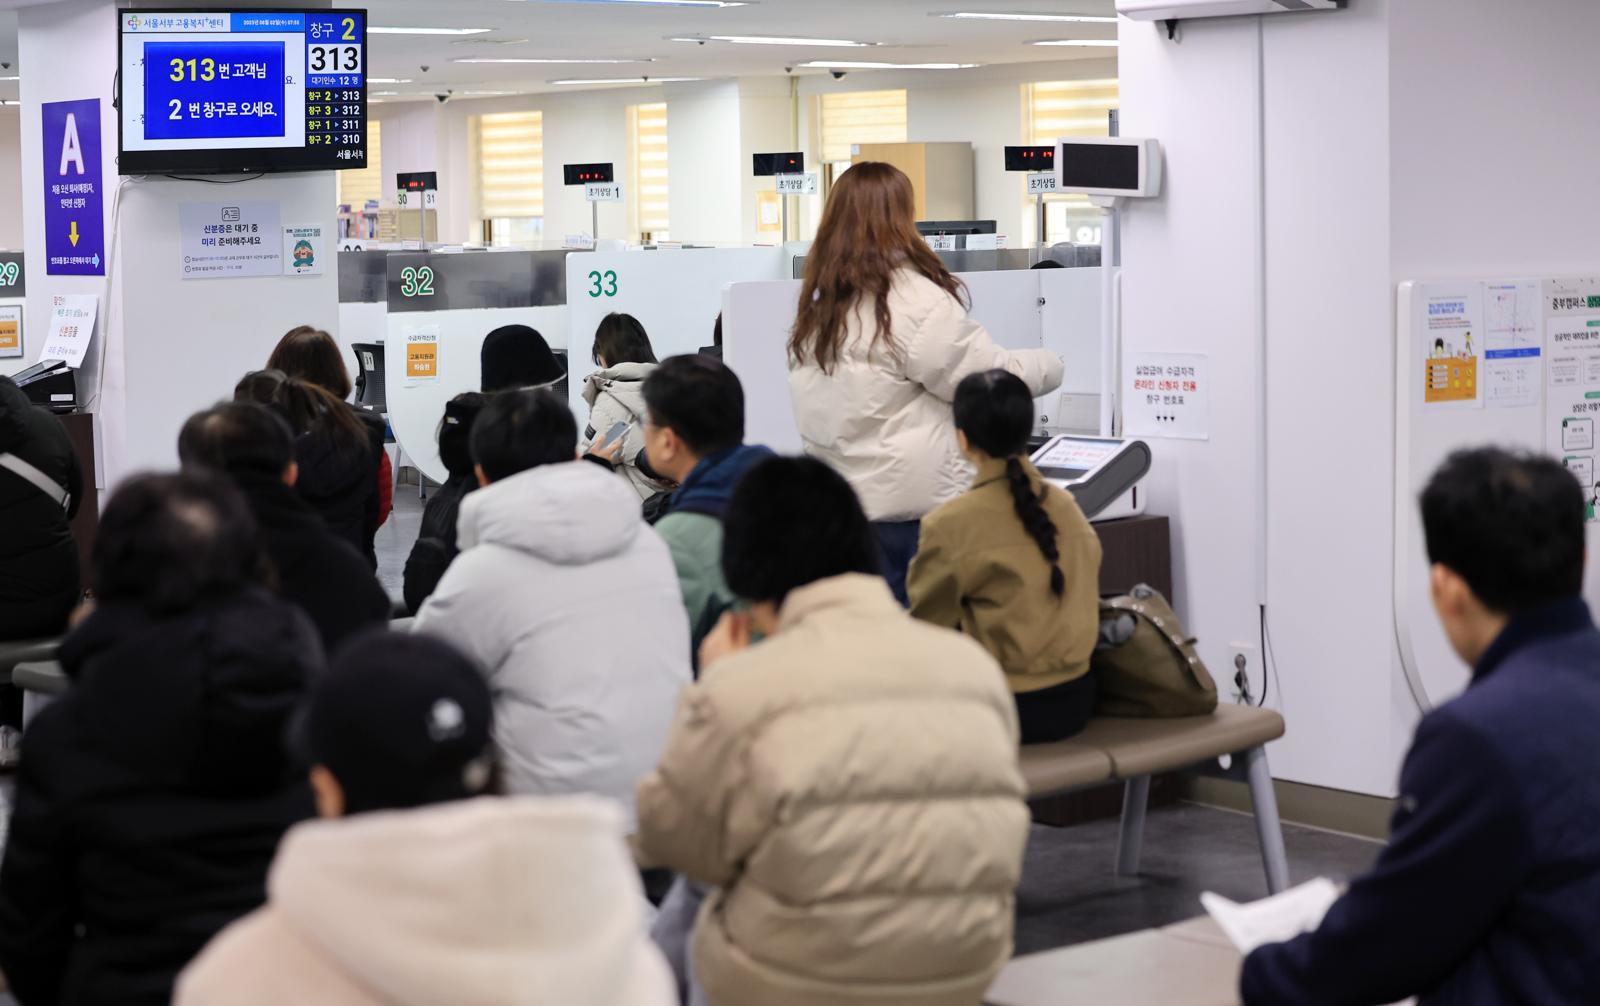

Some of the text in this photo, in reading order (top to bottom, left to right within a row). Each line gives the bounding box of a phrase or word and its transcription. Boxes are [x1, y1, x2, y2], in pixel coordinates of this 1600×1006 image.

[143, 18, 174, 29] 서울서부
[310, 17, 356, 41] 창구 2
[311, 46, 358, 71] 313
[169, 57, 267, 82] 313 번 고객님
[311, 76, 359, 86] 대기인수 12 명
[308, 91, 360, 101] 창구 2 313
[168, 98, 278, 120] 2 번 창구로 오세요.
[308, 105, 360, 115] 창구 3 312
[308, 120, 360, 130] 창구 1 311
[60, 112, 85, 176] A
[308, 134, 360, 144] 창구 2 310
[1031, 178, 1056, 189] 초기상담
[615, 186, 619, 199] 1
[398, 193, 407, 204] 30
[426, 193, 435, 204] 31
[204, 224, 259, 234] 신분증은 대기 중
[201, 236, 261, 247] 미리 준비해주세요
[401, 266, 434, 297] 32
[588, 270, 618, 297] 33
[1552, 296, 1586, 310] 중부캠퍼스
[1136, 365, 1195, 376] 실업급여 수급자격
[1147, 394, 1160, 405] 창구
